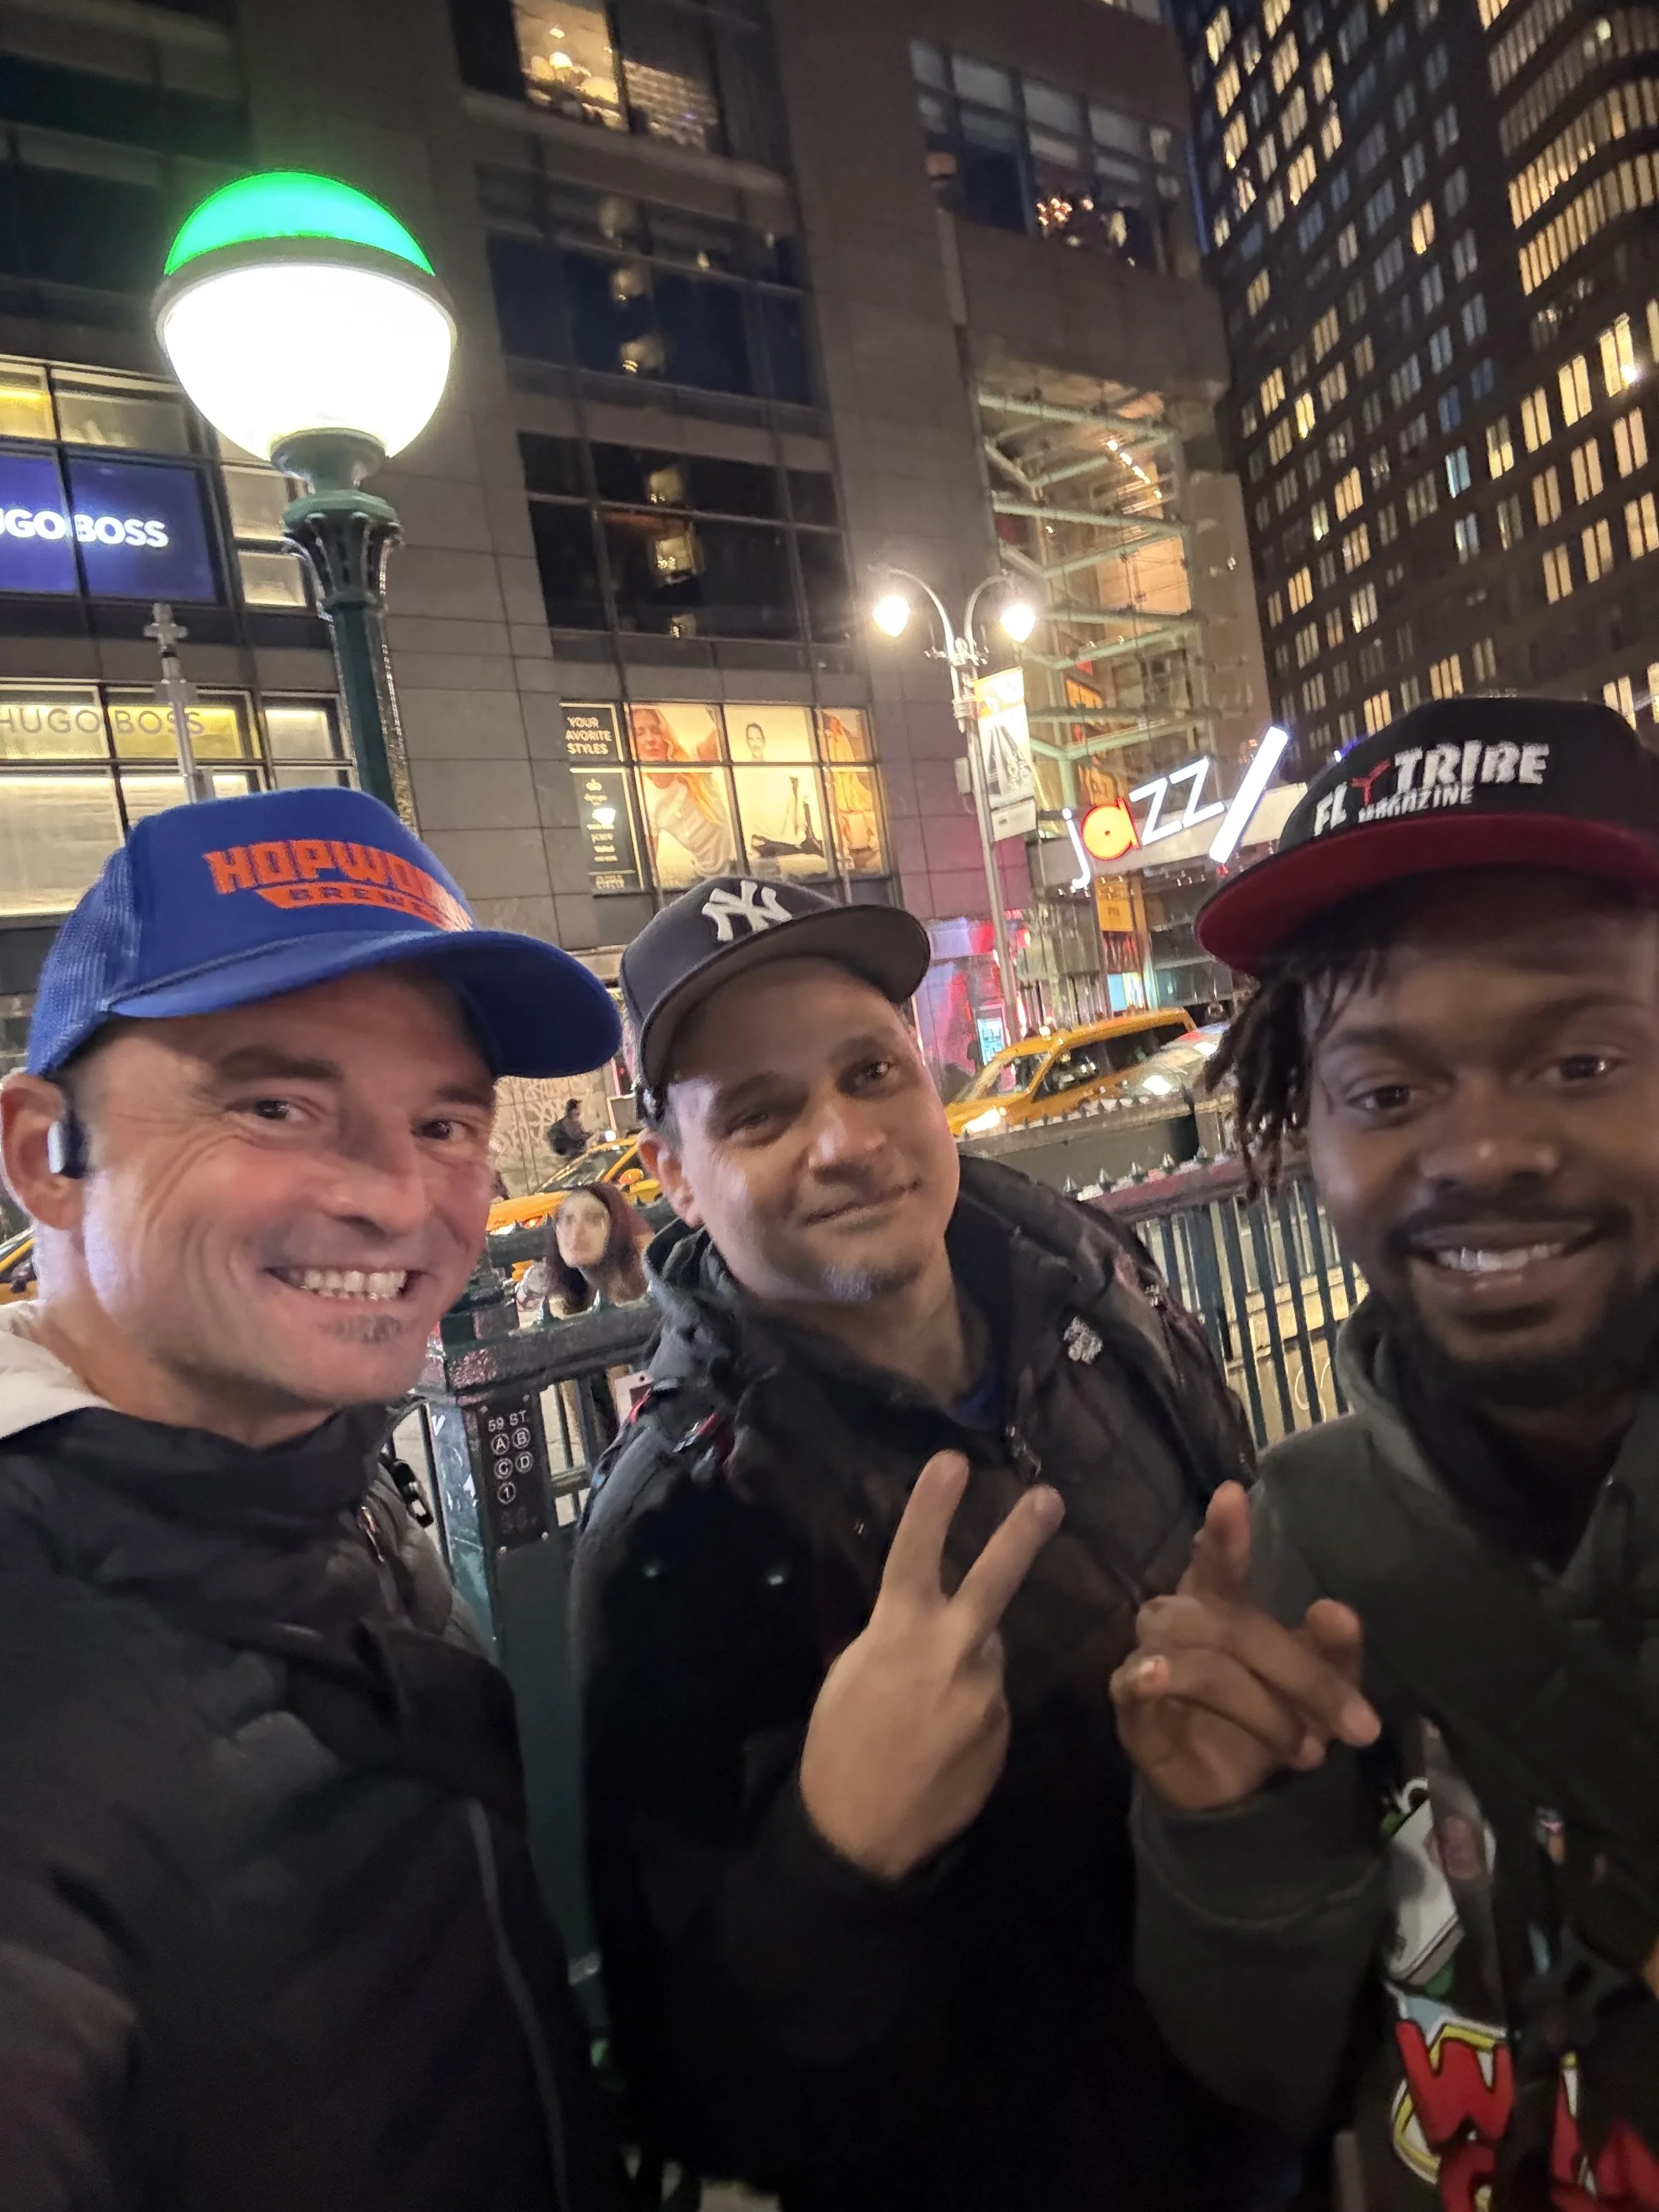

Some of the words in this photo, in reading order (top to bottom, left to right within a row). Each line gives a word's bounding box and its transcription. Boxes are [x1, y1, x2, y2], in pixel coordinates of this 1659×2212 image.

[0, 507, 66, 541] GO
[73, 513, 169, 548] BOSS
[566, 716, 600, 729] YOUR
[566, 743, 609, 755] STYLES
[1394, 739, 1550, 795] TRIBE
[1358, 782, 1475, 824] MAGAZINE
[701, 880, 793, 942] NY
[488, 1416, 504, 1432] 59
[509, 1410, 528, 1426] ST
